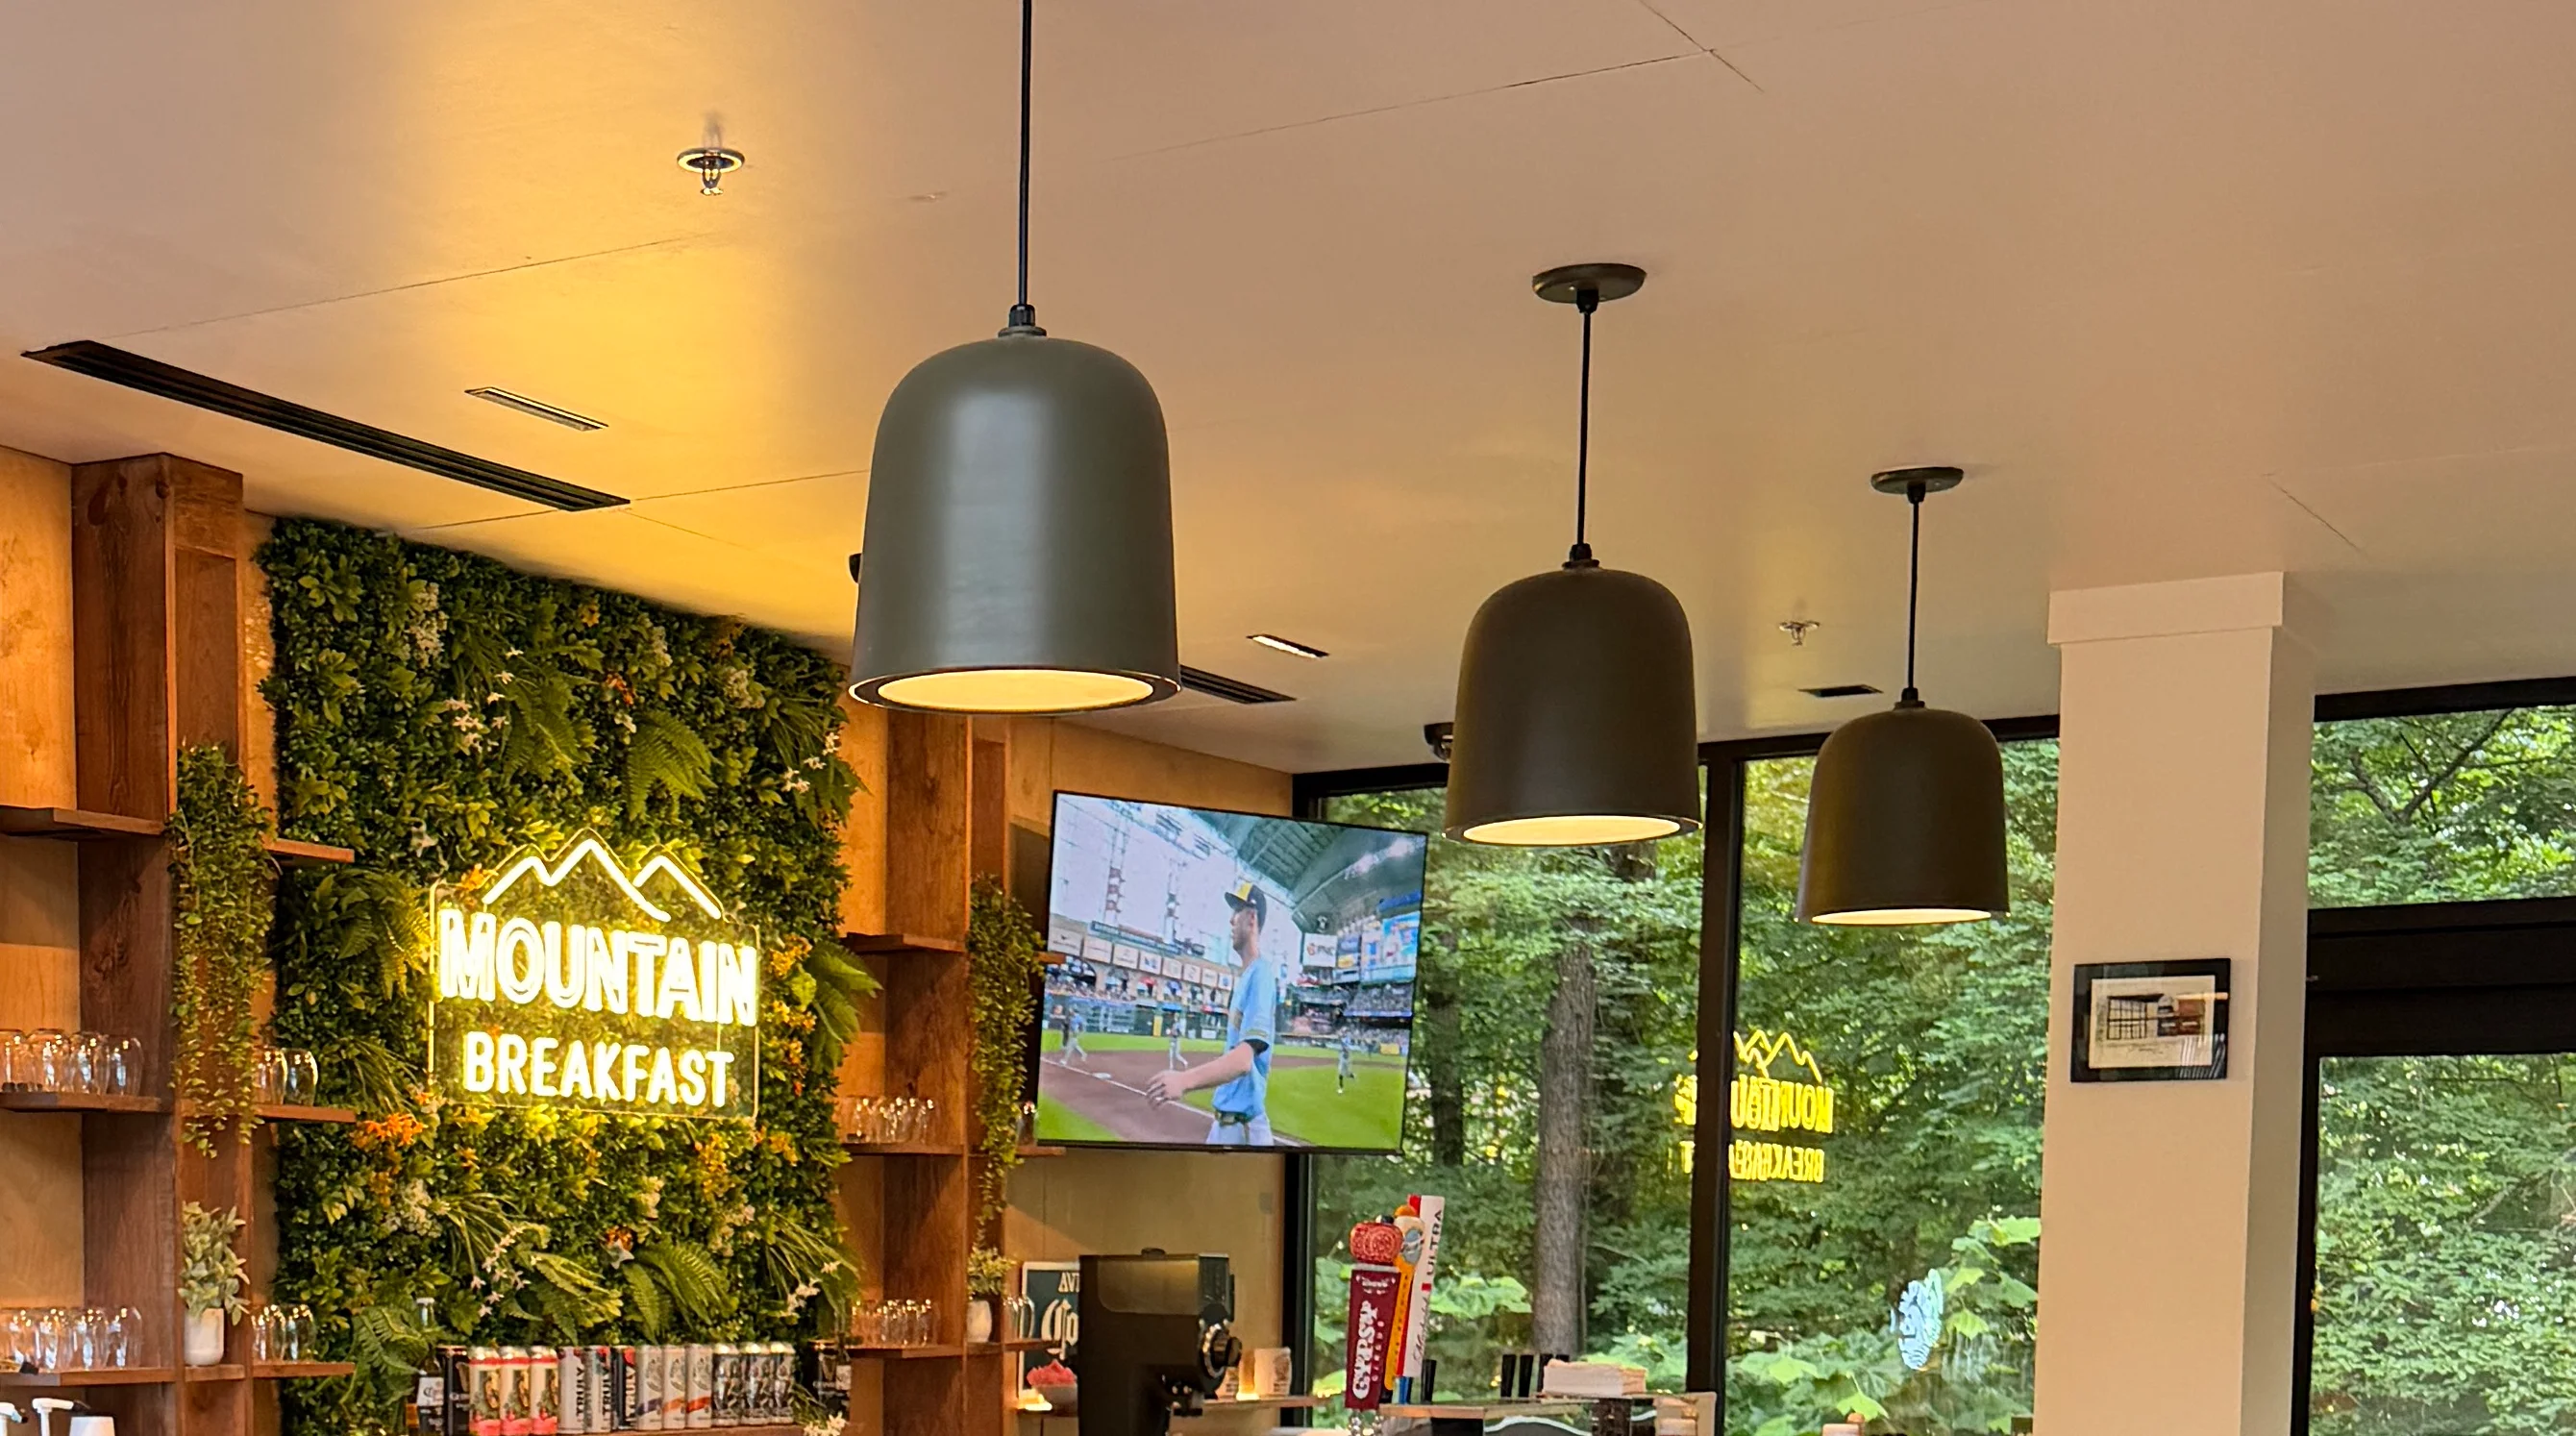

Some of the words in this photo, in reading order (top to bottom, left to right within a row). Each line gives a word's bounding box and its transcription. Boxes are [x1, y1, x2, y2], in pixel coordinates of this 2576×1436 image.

[437, 907, 757, 1027] MOUNTAIN
[463, 1030, 735, 1107] BREAKFAST
[1426, 1210, 1442, 1275] ULTRA
[1352, 1300, 1378, 1399] GYPSY
[576, 1367, 584, 1417] TRULY
[602, 1367, 611, 1417] TRULY
[625, 1366, 635, 1417] TRULY
